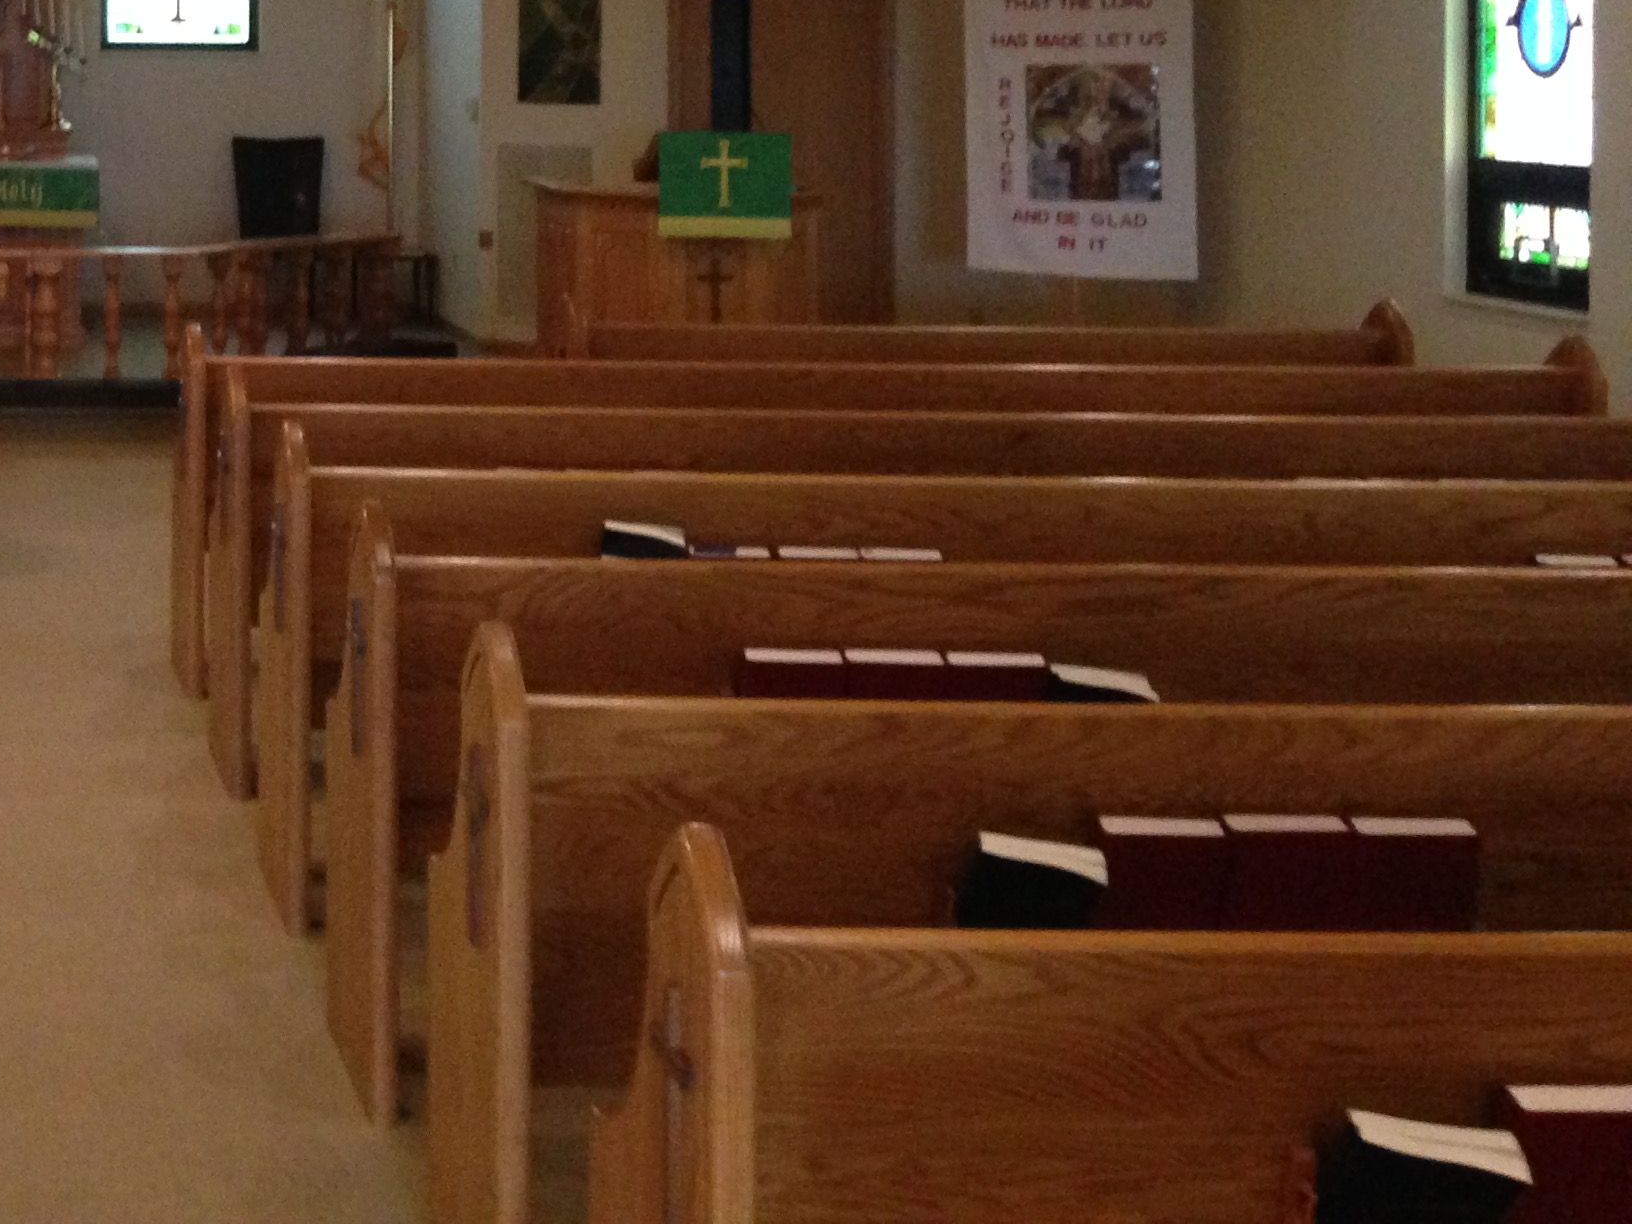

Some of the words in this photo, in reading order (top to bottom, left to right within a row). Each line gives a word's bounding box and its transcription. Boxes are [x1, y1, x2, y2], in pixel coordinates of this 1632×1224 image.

[990, 32, 1028, 48] HAS
[1035, 33, 1085, 48] MADE
[1095, 33, 1132, 48] LET
[1138, 31, 1167, 46] US
[1012, 209, 1050, 225] AND
[1056, 210, 1079, 226] BE
[1090, 212, 1148, 228] GLAD
[1057, 236, 1077, 250] IN
[1089, 238, 1108, 252] IT
